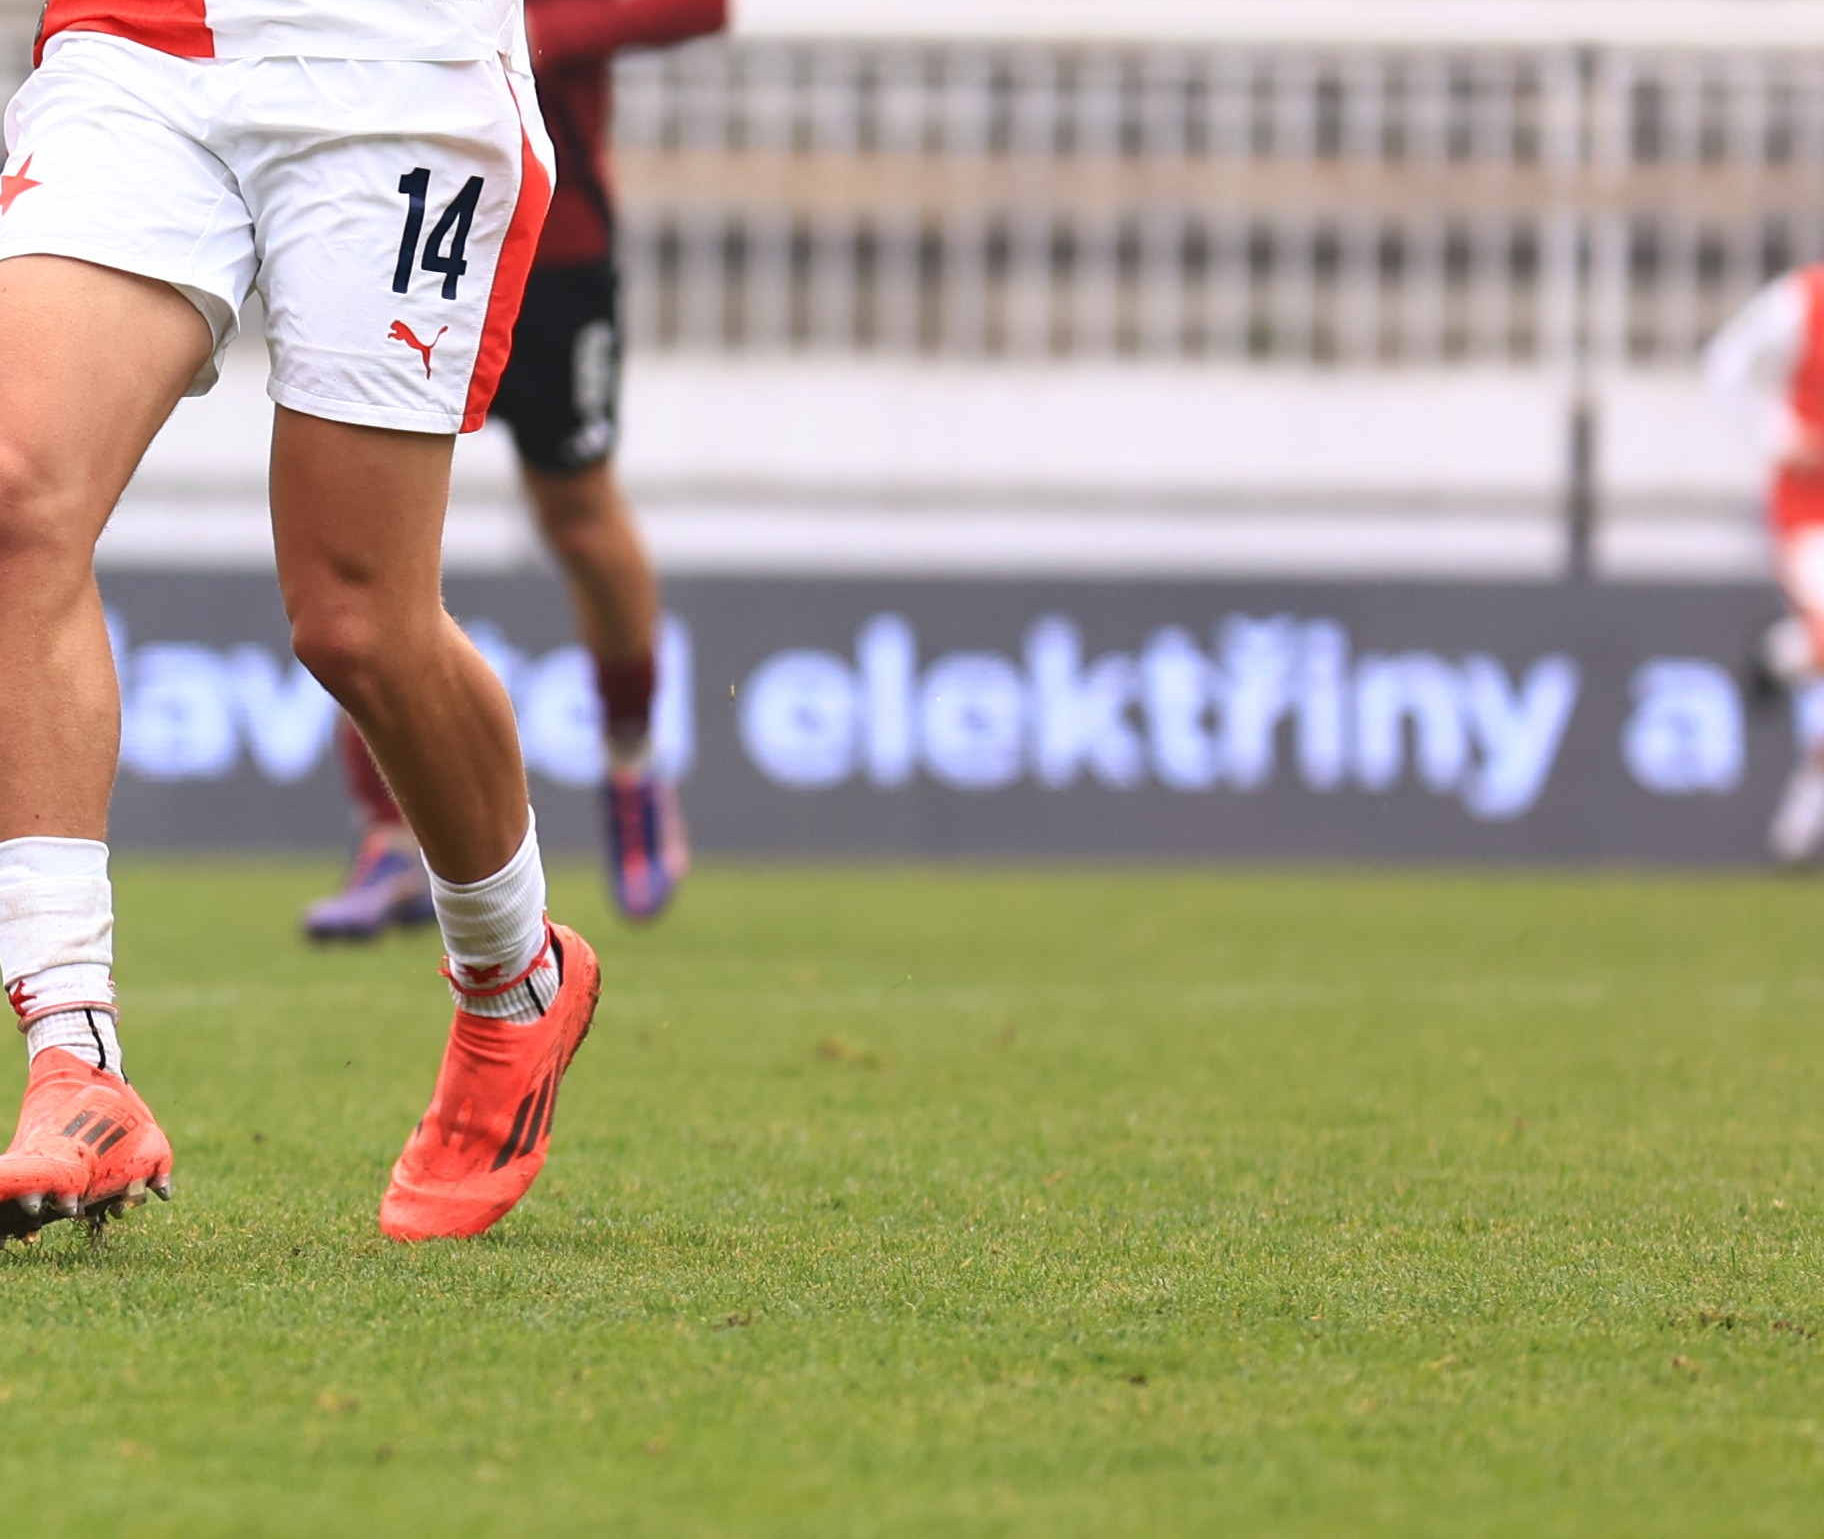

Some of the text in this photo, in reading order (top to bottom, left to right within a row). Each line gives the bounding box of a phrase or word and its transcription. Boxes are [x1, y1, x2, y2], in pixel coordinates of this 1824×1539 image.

[391, 166, 485, 300] 14
[740, 609, 1578, 819] elektřiny
[1620, 656, 1748, 793] a
